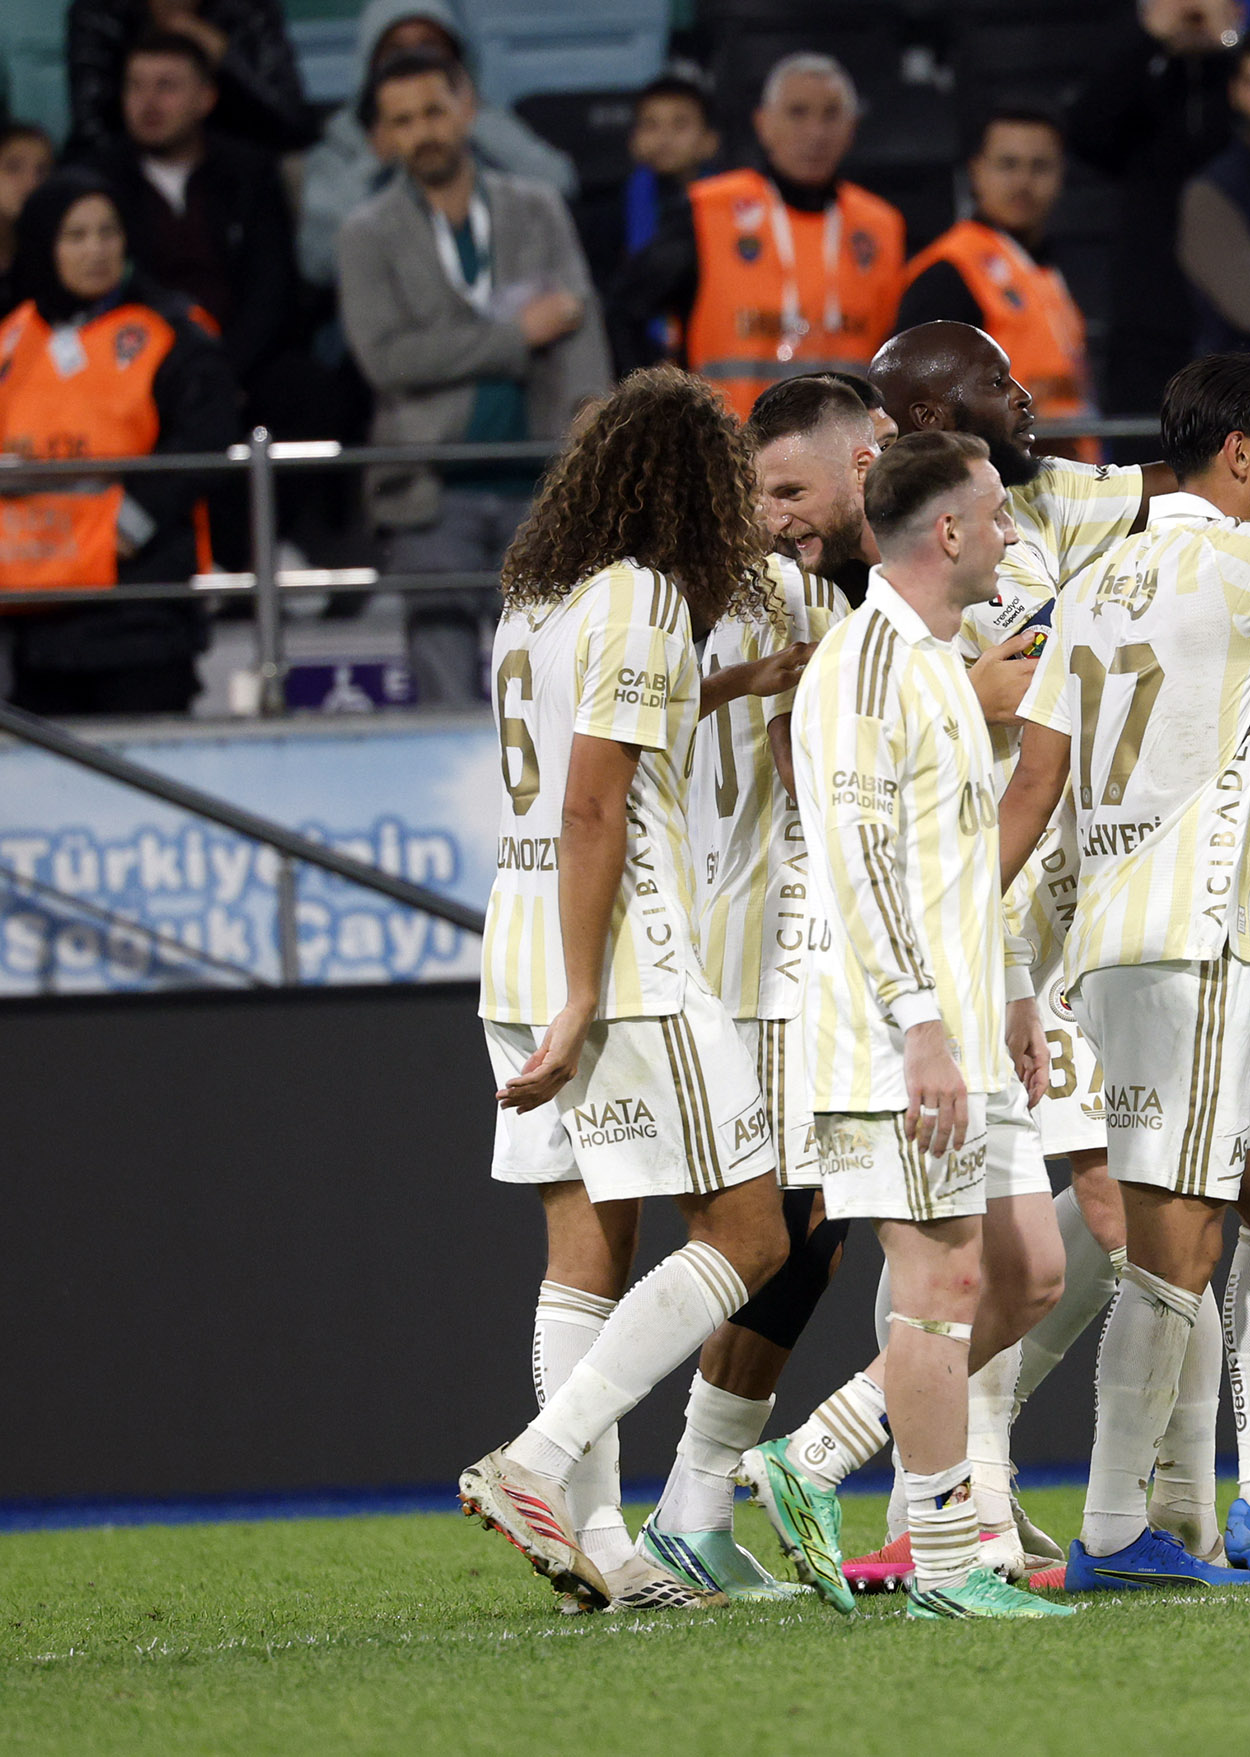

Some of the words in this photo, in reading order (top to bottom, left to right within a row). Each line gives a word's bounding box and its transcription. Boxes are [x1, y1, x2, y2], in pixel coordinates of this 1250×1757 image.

[496, 649, 540, 817] 6
[1069, 642, 1165, 810] 17
[572, 1097, 656, 1132] NATA
[579, 1123, 658, 1149] HOLDING
[818, 1154, 875, 1177] OLDING
